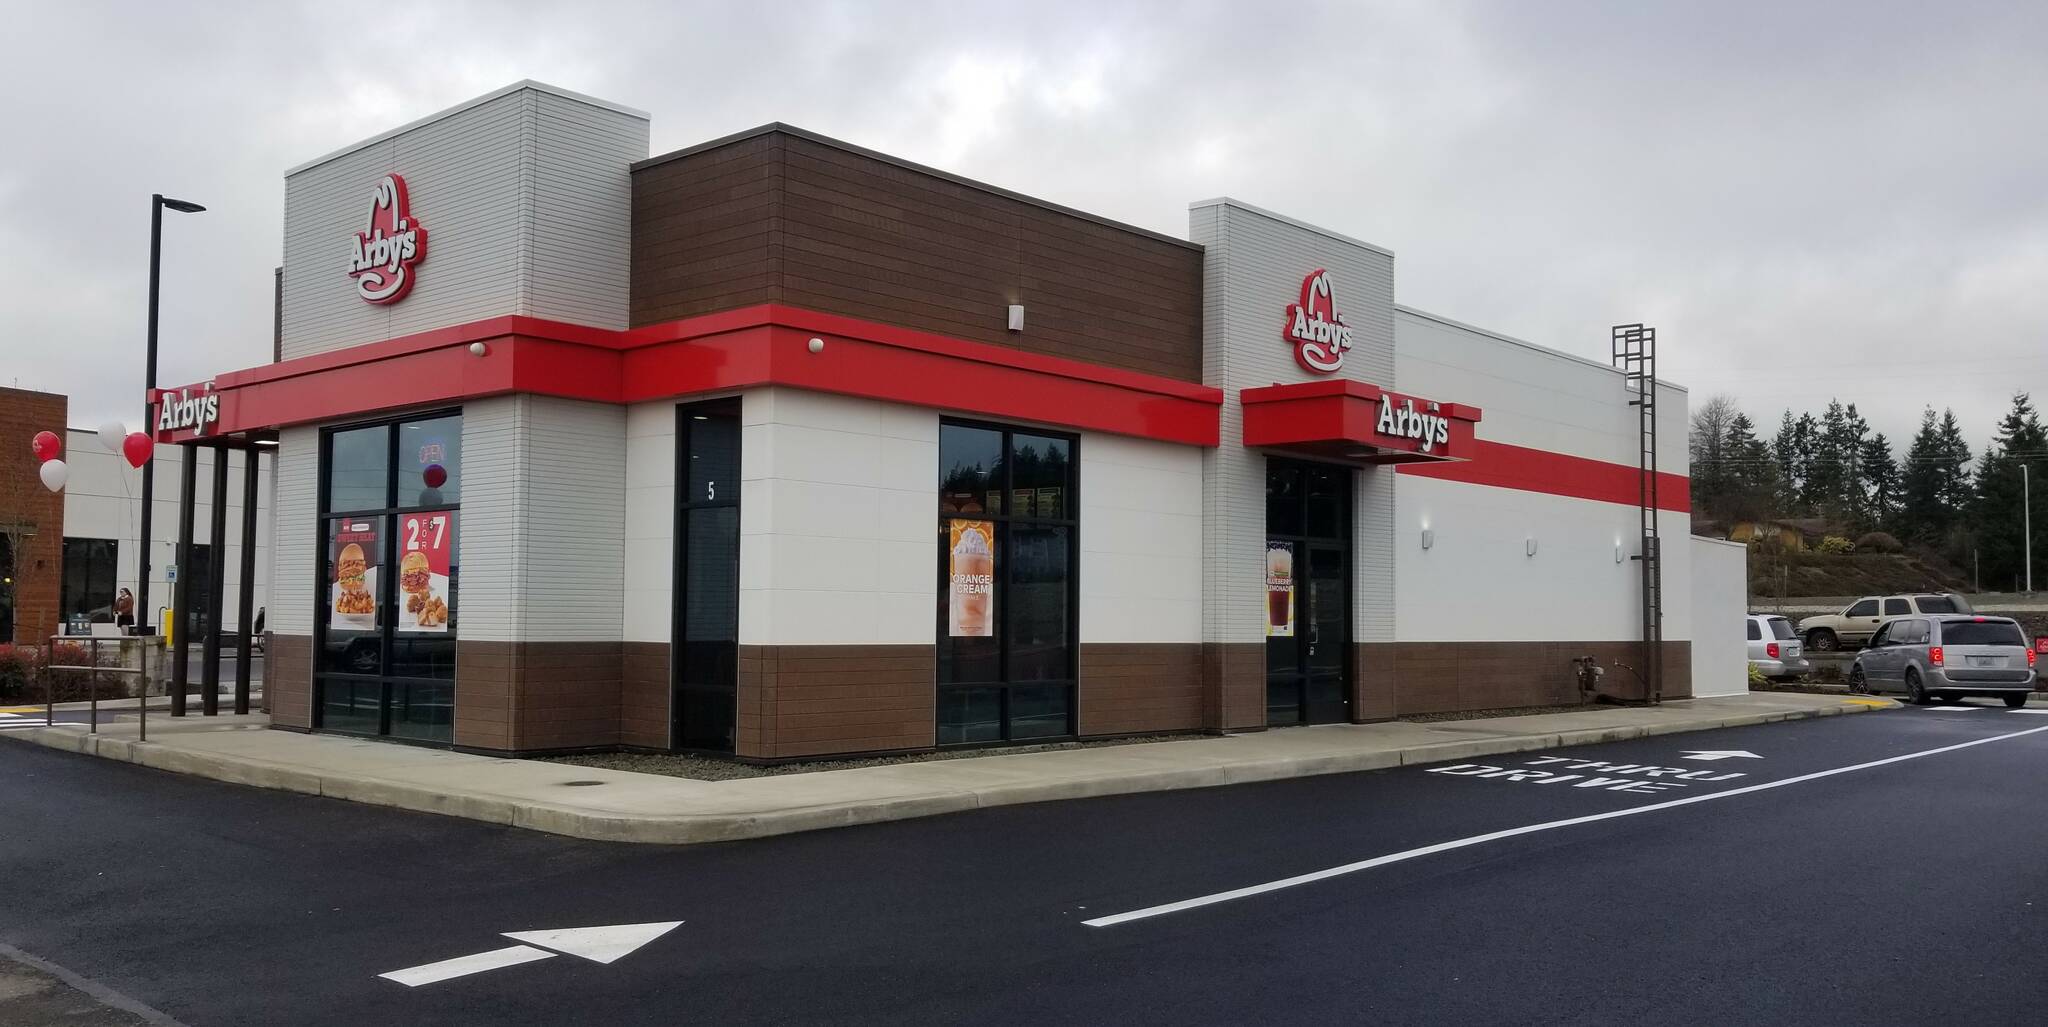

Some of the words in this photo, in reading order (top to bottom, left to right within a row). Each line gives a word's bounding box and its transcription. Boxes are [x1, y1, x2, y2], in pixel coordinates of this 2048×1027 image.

[347, 219, 416, 274] Arby's
[1292, 306, 1352, 354] Arby's
[159, 382, 217, 436] Arby's
[1377, 394, 1448, 452] Arby's
[708, 481, 715, 500] 5
[407, 518, 420, 550] 2
[953, 574, 990, 584] ORANGE
[957, 584, 988, 594] CREAM
[1424, 764, 1689, 794] DRIVE
[1523, 756, 1748, 781] THRU
